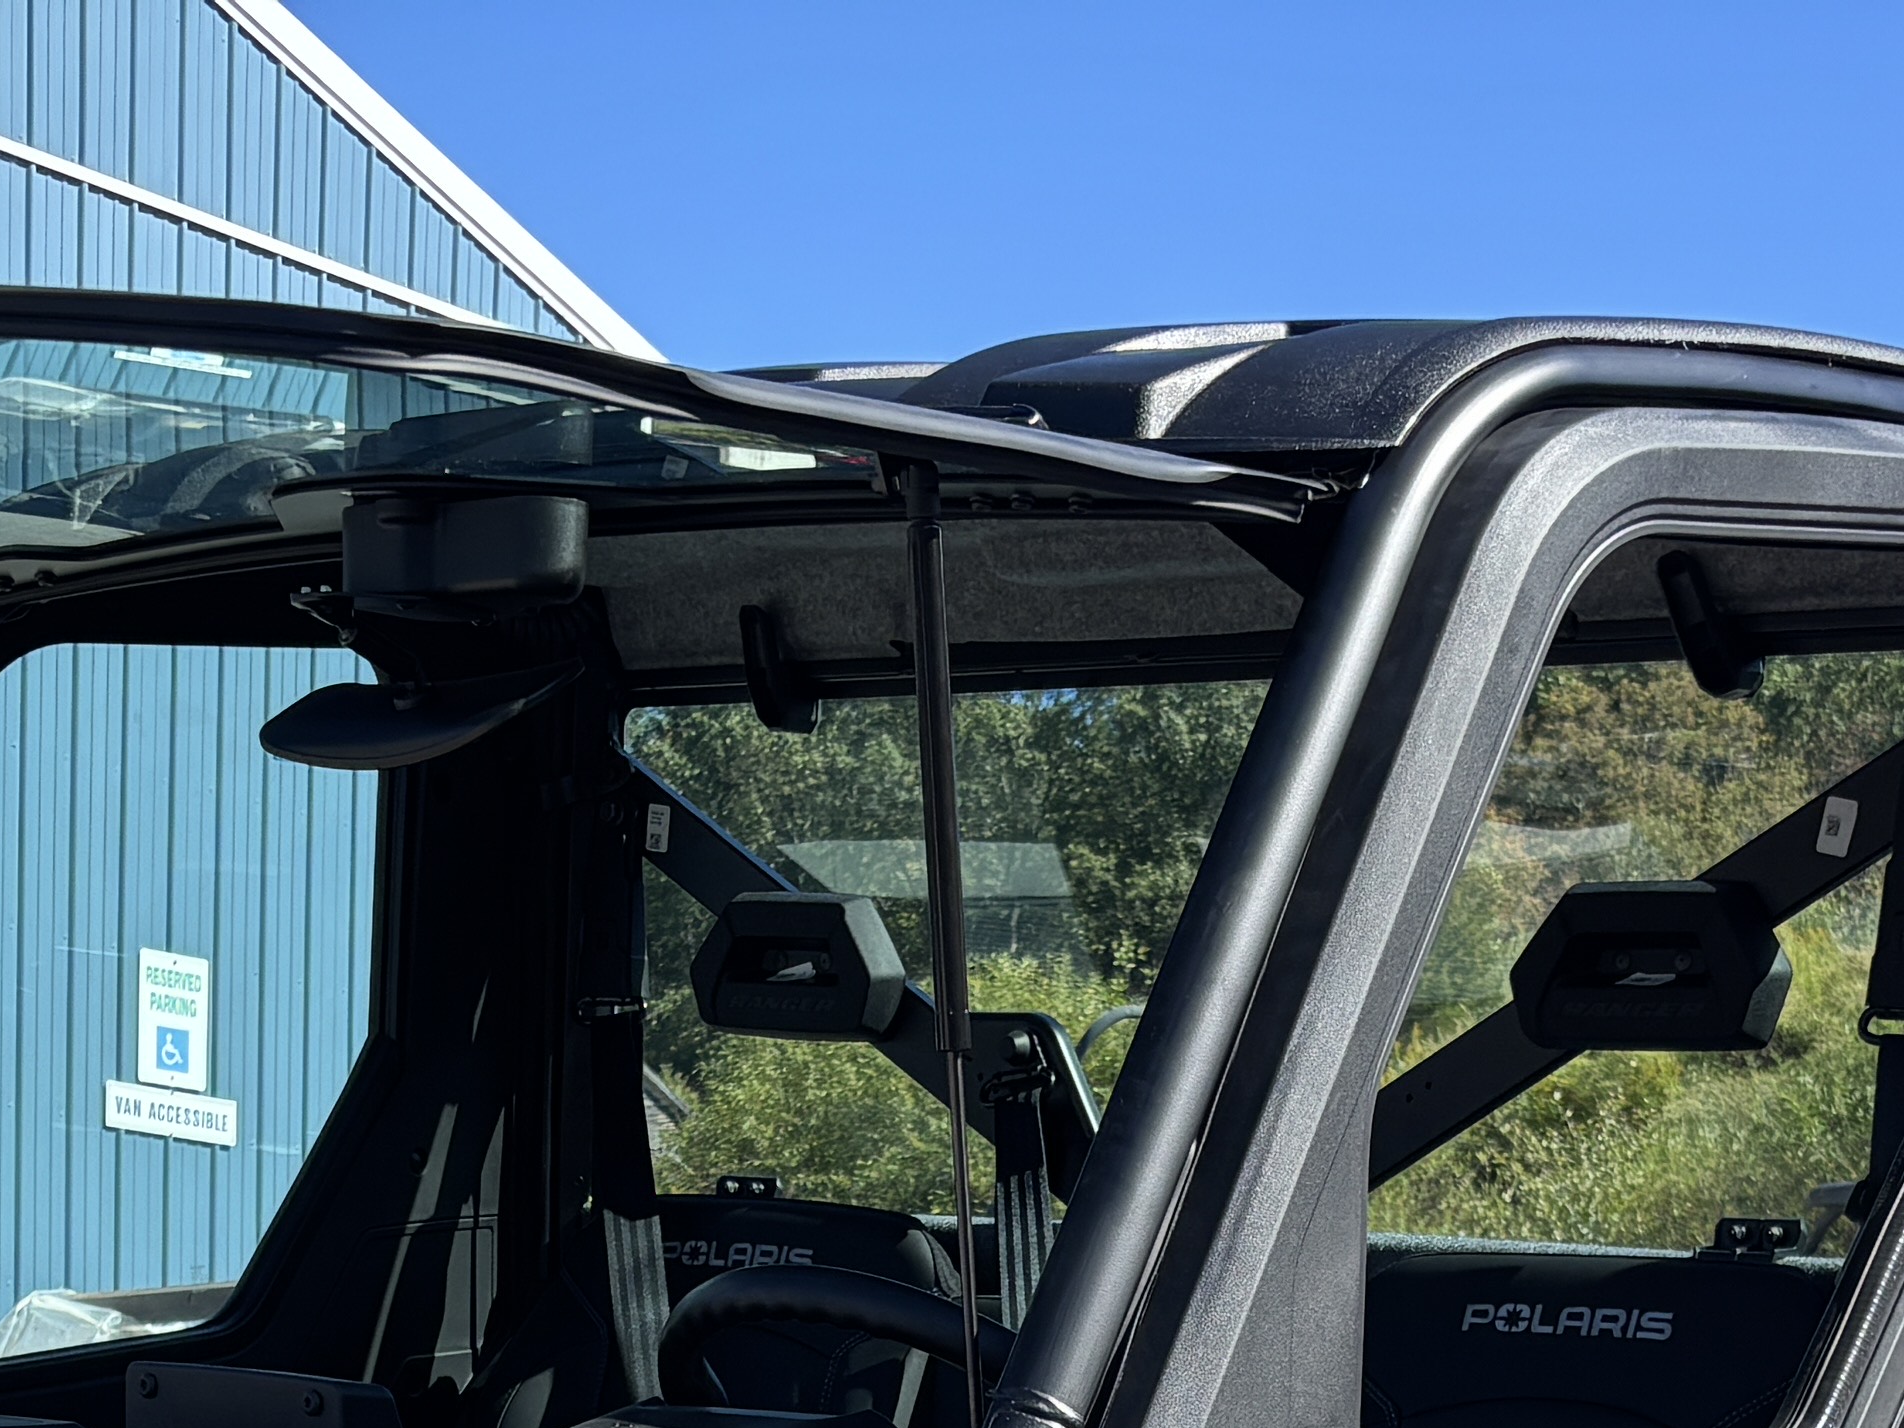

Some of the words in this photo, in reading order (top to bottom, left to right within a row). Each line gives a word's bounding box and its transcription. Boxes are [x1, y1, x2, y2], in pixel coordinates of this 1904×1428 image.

[146, 965, 202, 993] RESERVED
[150, 992, 197, 1018] PARKING
[116, 1095, 142, 1119] VAN
[149, 1105, 228, 1133] ACCESSIBLE
[1462, 1303, 1673, 1341] POLARIS
